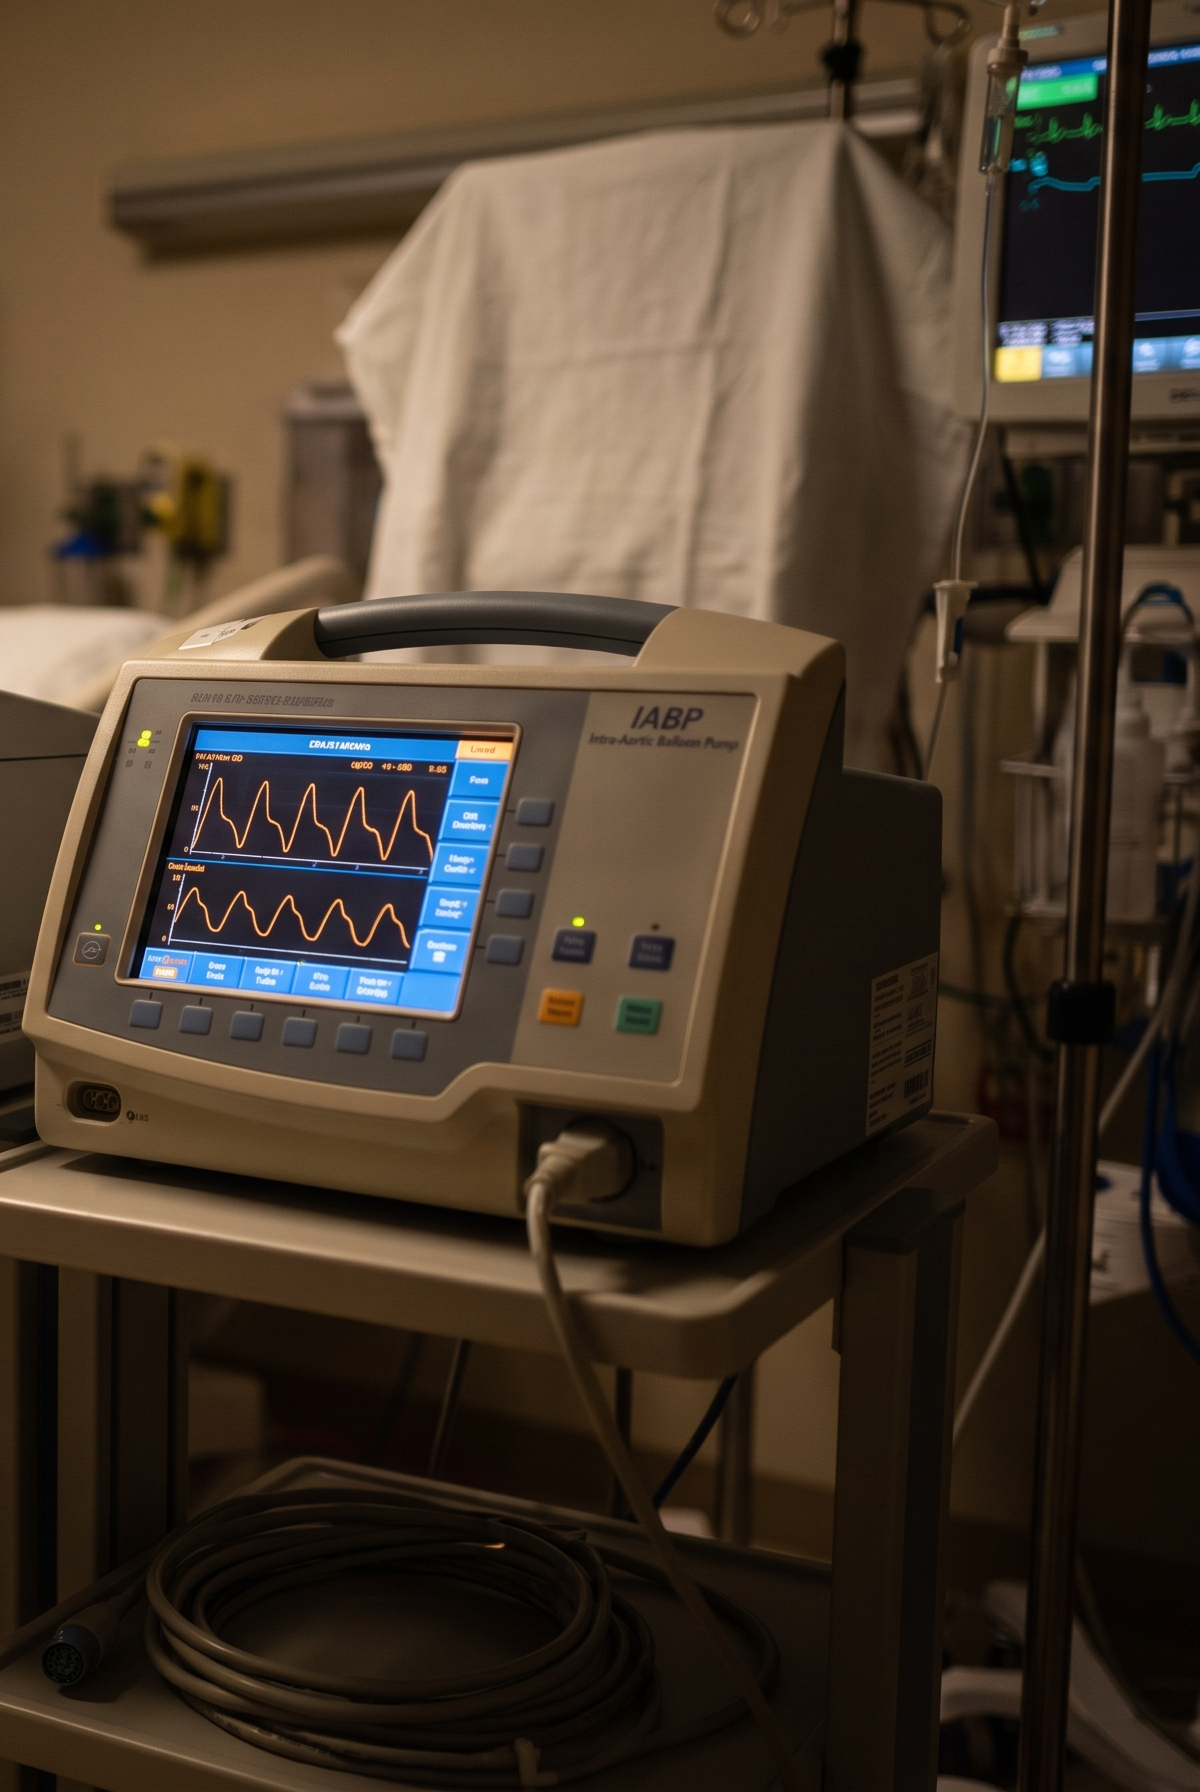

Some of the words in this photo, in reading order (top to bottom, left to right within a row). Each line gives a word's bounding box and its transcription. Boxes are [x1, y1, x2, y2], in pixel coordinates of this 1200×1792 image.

[630, 706, 704, 731] IABP
[588, 733, 654, 748] Intra-Aortic
[657, 735, 700, 749] Balloon
[703, 736, 740, 752] Pump
